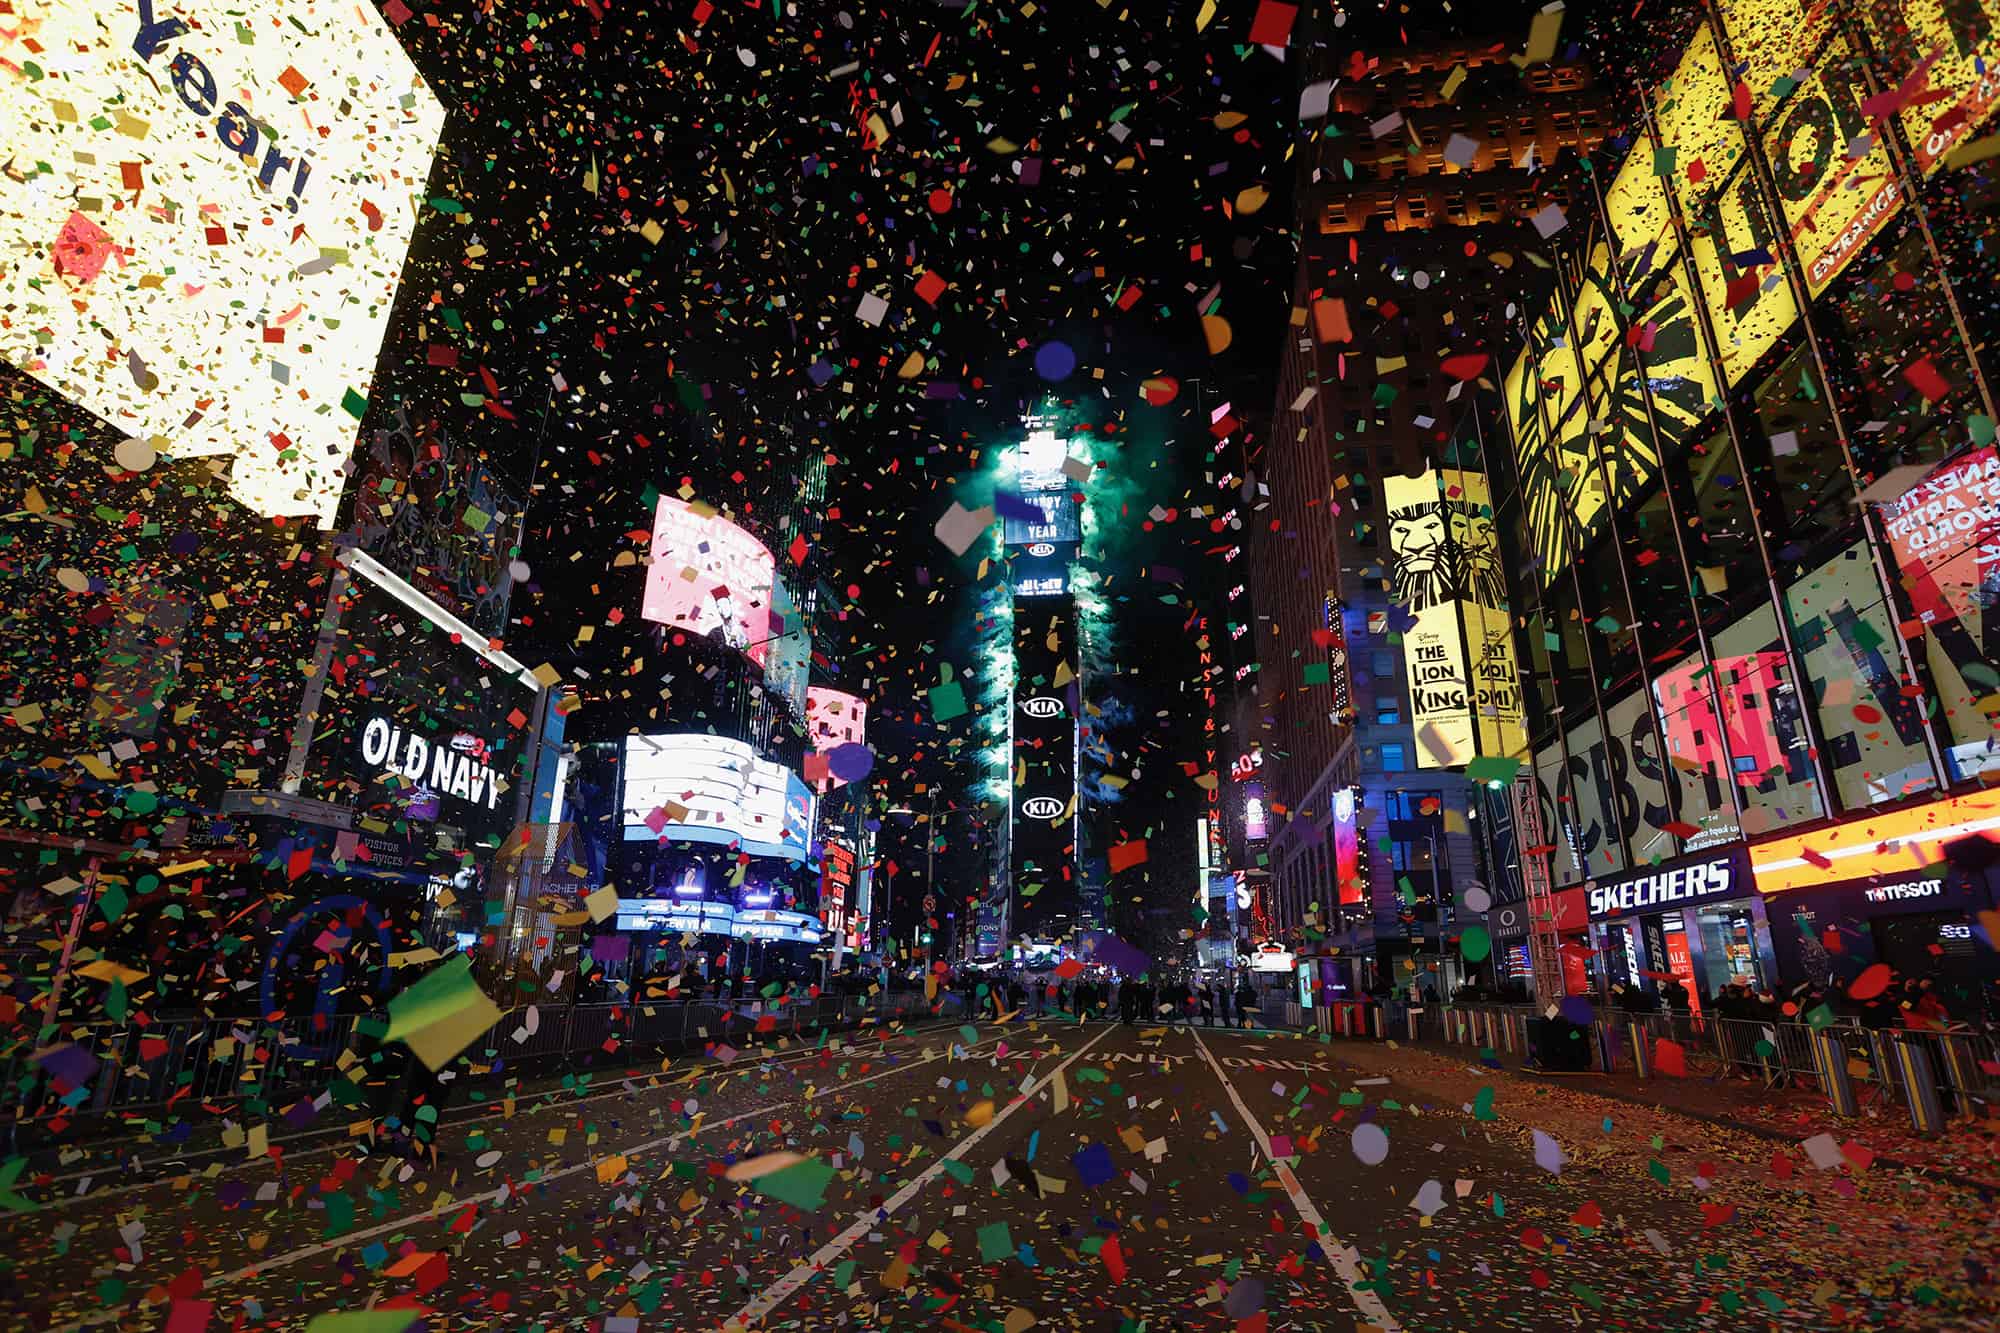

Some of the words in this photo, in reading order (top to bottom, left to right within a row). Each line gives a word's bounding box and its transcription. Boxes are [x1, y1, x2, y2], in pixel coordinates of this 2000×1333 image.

[131, 0, 312, 215] Year!
[1811, 182, 1899, 282] ENTRANCE
[1028, 526, 1057, 538] YEAR
[1415, 644, 1446, 660] THE
[1412, 663, 1455, 686] LION
[1030, 700, 1056, 713] KIA
[1412, 687, 1465, 715] KING
[362, 717, 428, 780] OLD
[430, 745, 505, 810] NAVY
[1029, 801, 1057, 815] KIA
[364, 837, 399, 853] VISITOR
[1590, 858, 1729, 916] SKECHERS
